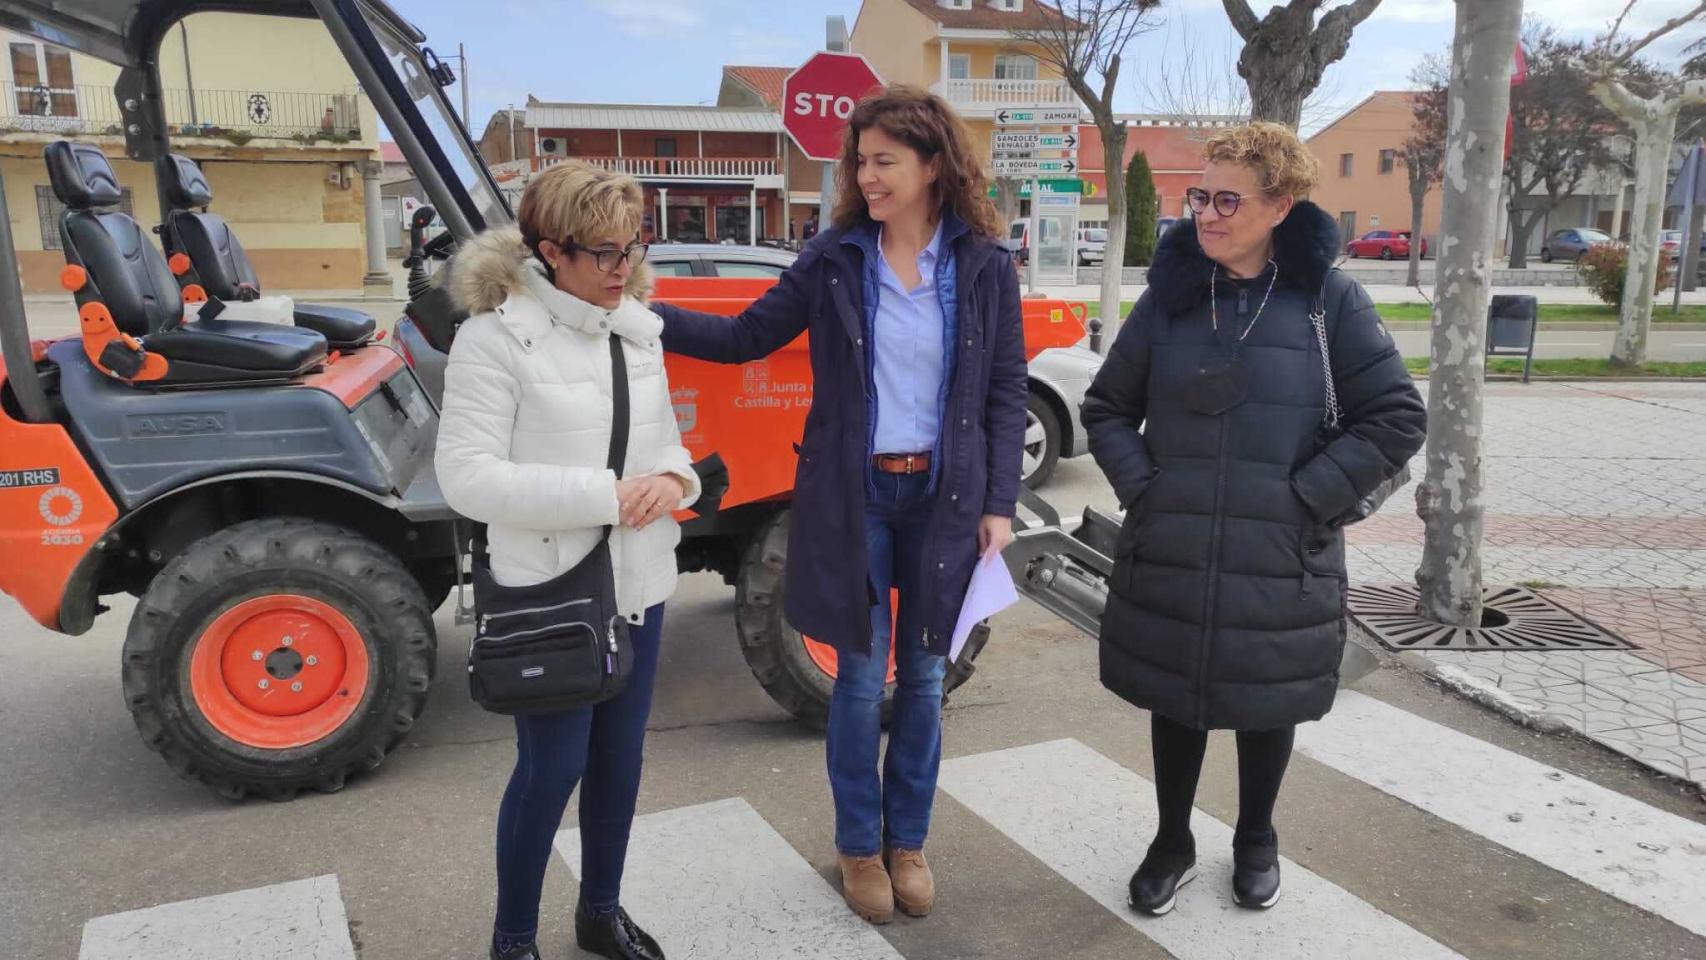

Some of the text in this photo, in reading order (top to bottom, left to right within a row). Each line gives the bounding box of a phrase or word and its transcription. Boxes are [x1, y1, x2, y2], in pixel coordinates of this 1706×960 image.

[794, 92, 855, 119] STO
[1021, 183, 1054, 193] RUAL
[769, 381, 807, 393] Junta
[735, 395, 813, 410] Castilla y Le
[139, 415, 225, 433] AUSA
[23, 470, 54, 485] RHS
[42, 535, 84, 545] 2030
